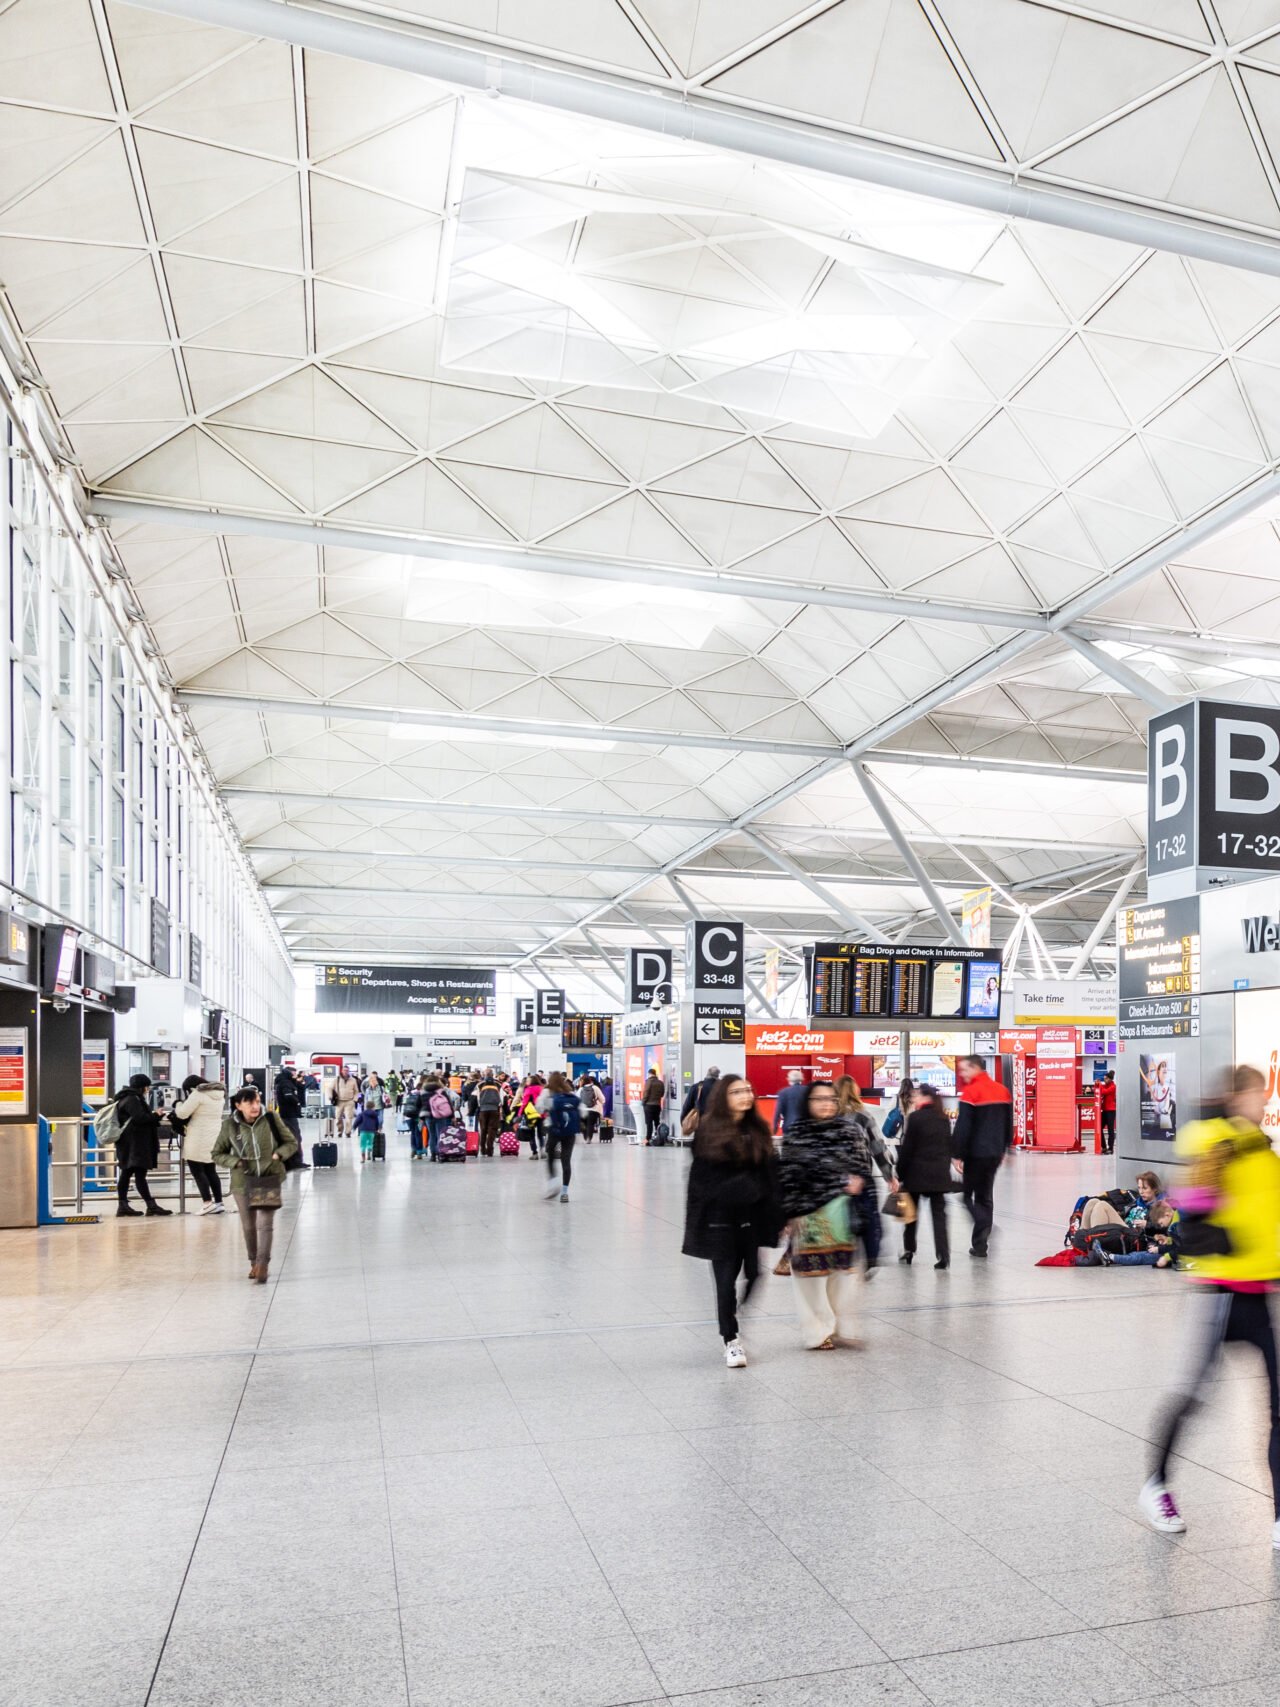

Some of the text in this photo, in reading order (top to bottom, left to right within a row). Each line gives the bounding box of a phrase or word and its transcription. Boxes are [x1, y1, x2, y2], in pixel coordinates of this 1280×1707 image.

[1155, 723, 1187, 822] B
[1155, 834, 1186, 861] 17-32
[1134, 908, 1166, 924] Departures
[1134, 924, 1165, 941] UK Arrivals
[701, 927, 737, 967] C
[860, 947, 875, 956] Bag
[877, 947, 895, 956] Drop
[911, 948, 934, 956] Check
[944, 949, 984, 958] Information
[1125, 941, 1182, 960] International Arrivals
[338, 968, 373, 978] Security
[637, 953, 666, 986] D
[1148, 960, 1182, 976] Information
[361, 978, 410, 987] Departures,
[411, 979, 437, 988] Shops
[446, 981, 494, 989] Restaurants
[703, 974, 736, 984] 33-48
[1146, 980, 1166, 994] Toilets
[407, 996, 437, 1004] Access
[542, 992, 561, 1015] E
[1023, 993, 1065, 1003] Take time
[433, 1006, 474, 1014] Fast Track
[698, 1006, 742, 1015] UK Arrivals
[1129, 1002, 1182, 1018] Check-In Zone 500
[1089, 1031, 1101, 1039] 34
[1120, 1022, 1174, 1038] Shops & Restaurants
[756, 1031, 824, 1043] Jet2.com
[870, 1035, 946, 1048] Jet2olidays
[756, 1043, 788, 1052] Friendly
[788, 1043, 802, 1051] low
